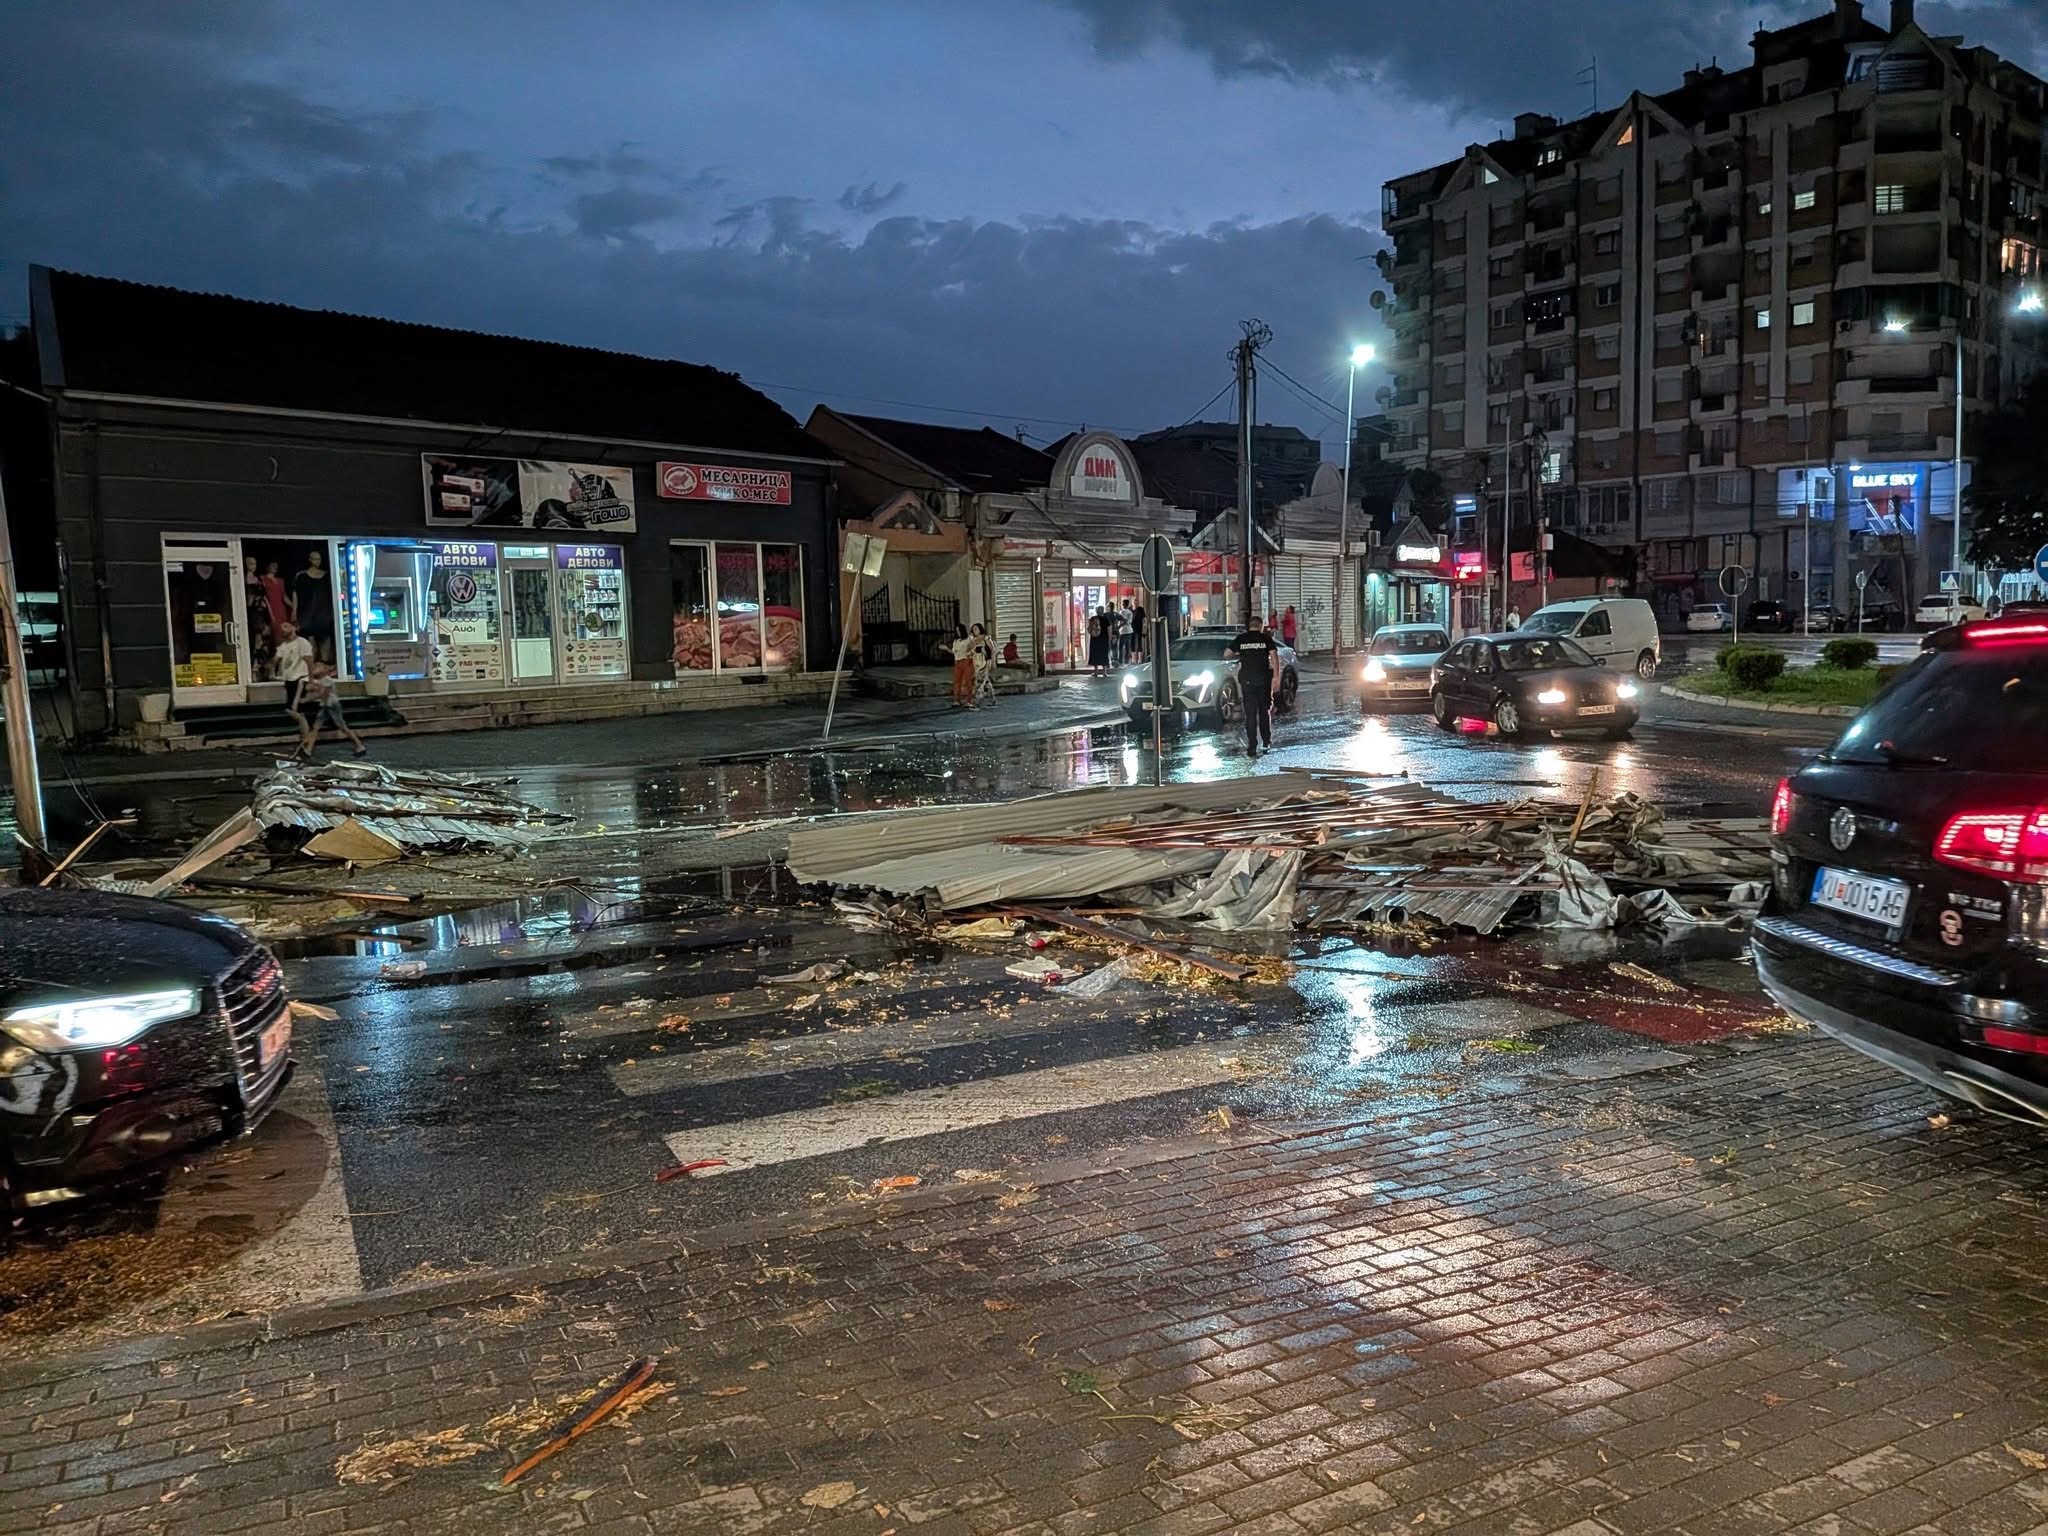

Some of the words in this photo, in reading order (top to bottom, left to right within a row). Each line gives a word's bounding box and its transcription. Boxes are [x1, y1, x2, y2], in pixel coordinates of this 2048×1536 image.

[702, 469, 787, 489] МЕСАРНИЦА
[1853, 475, 1889, 487] BLUE
[1890, 474, 1918, 486] SKY
[443, 544, 477, 554] АВТО
[575, 547, 606, 557] АВТО
[434, 556, 487, 567] ДЕЛОВИ
[567, 558, 614, 568] ДЕЛОВИ
